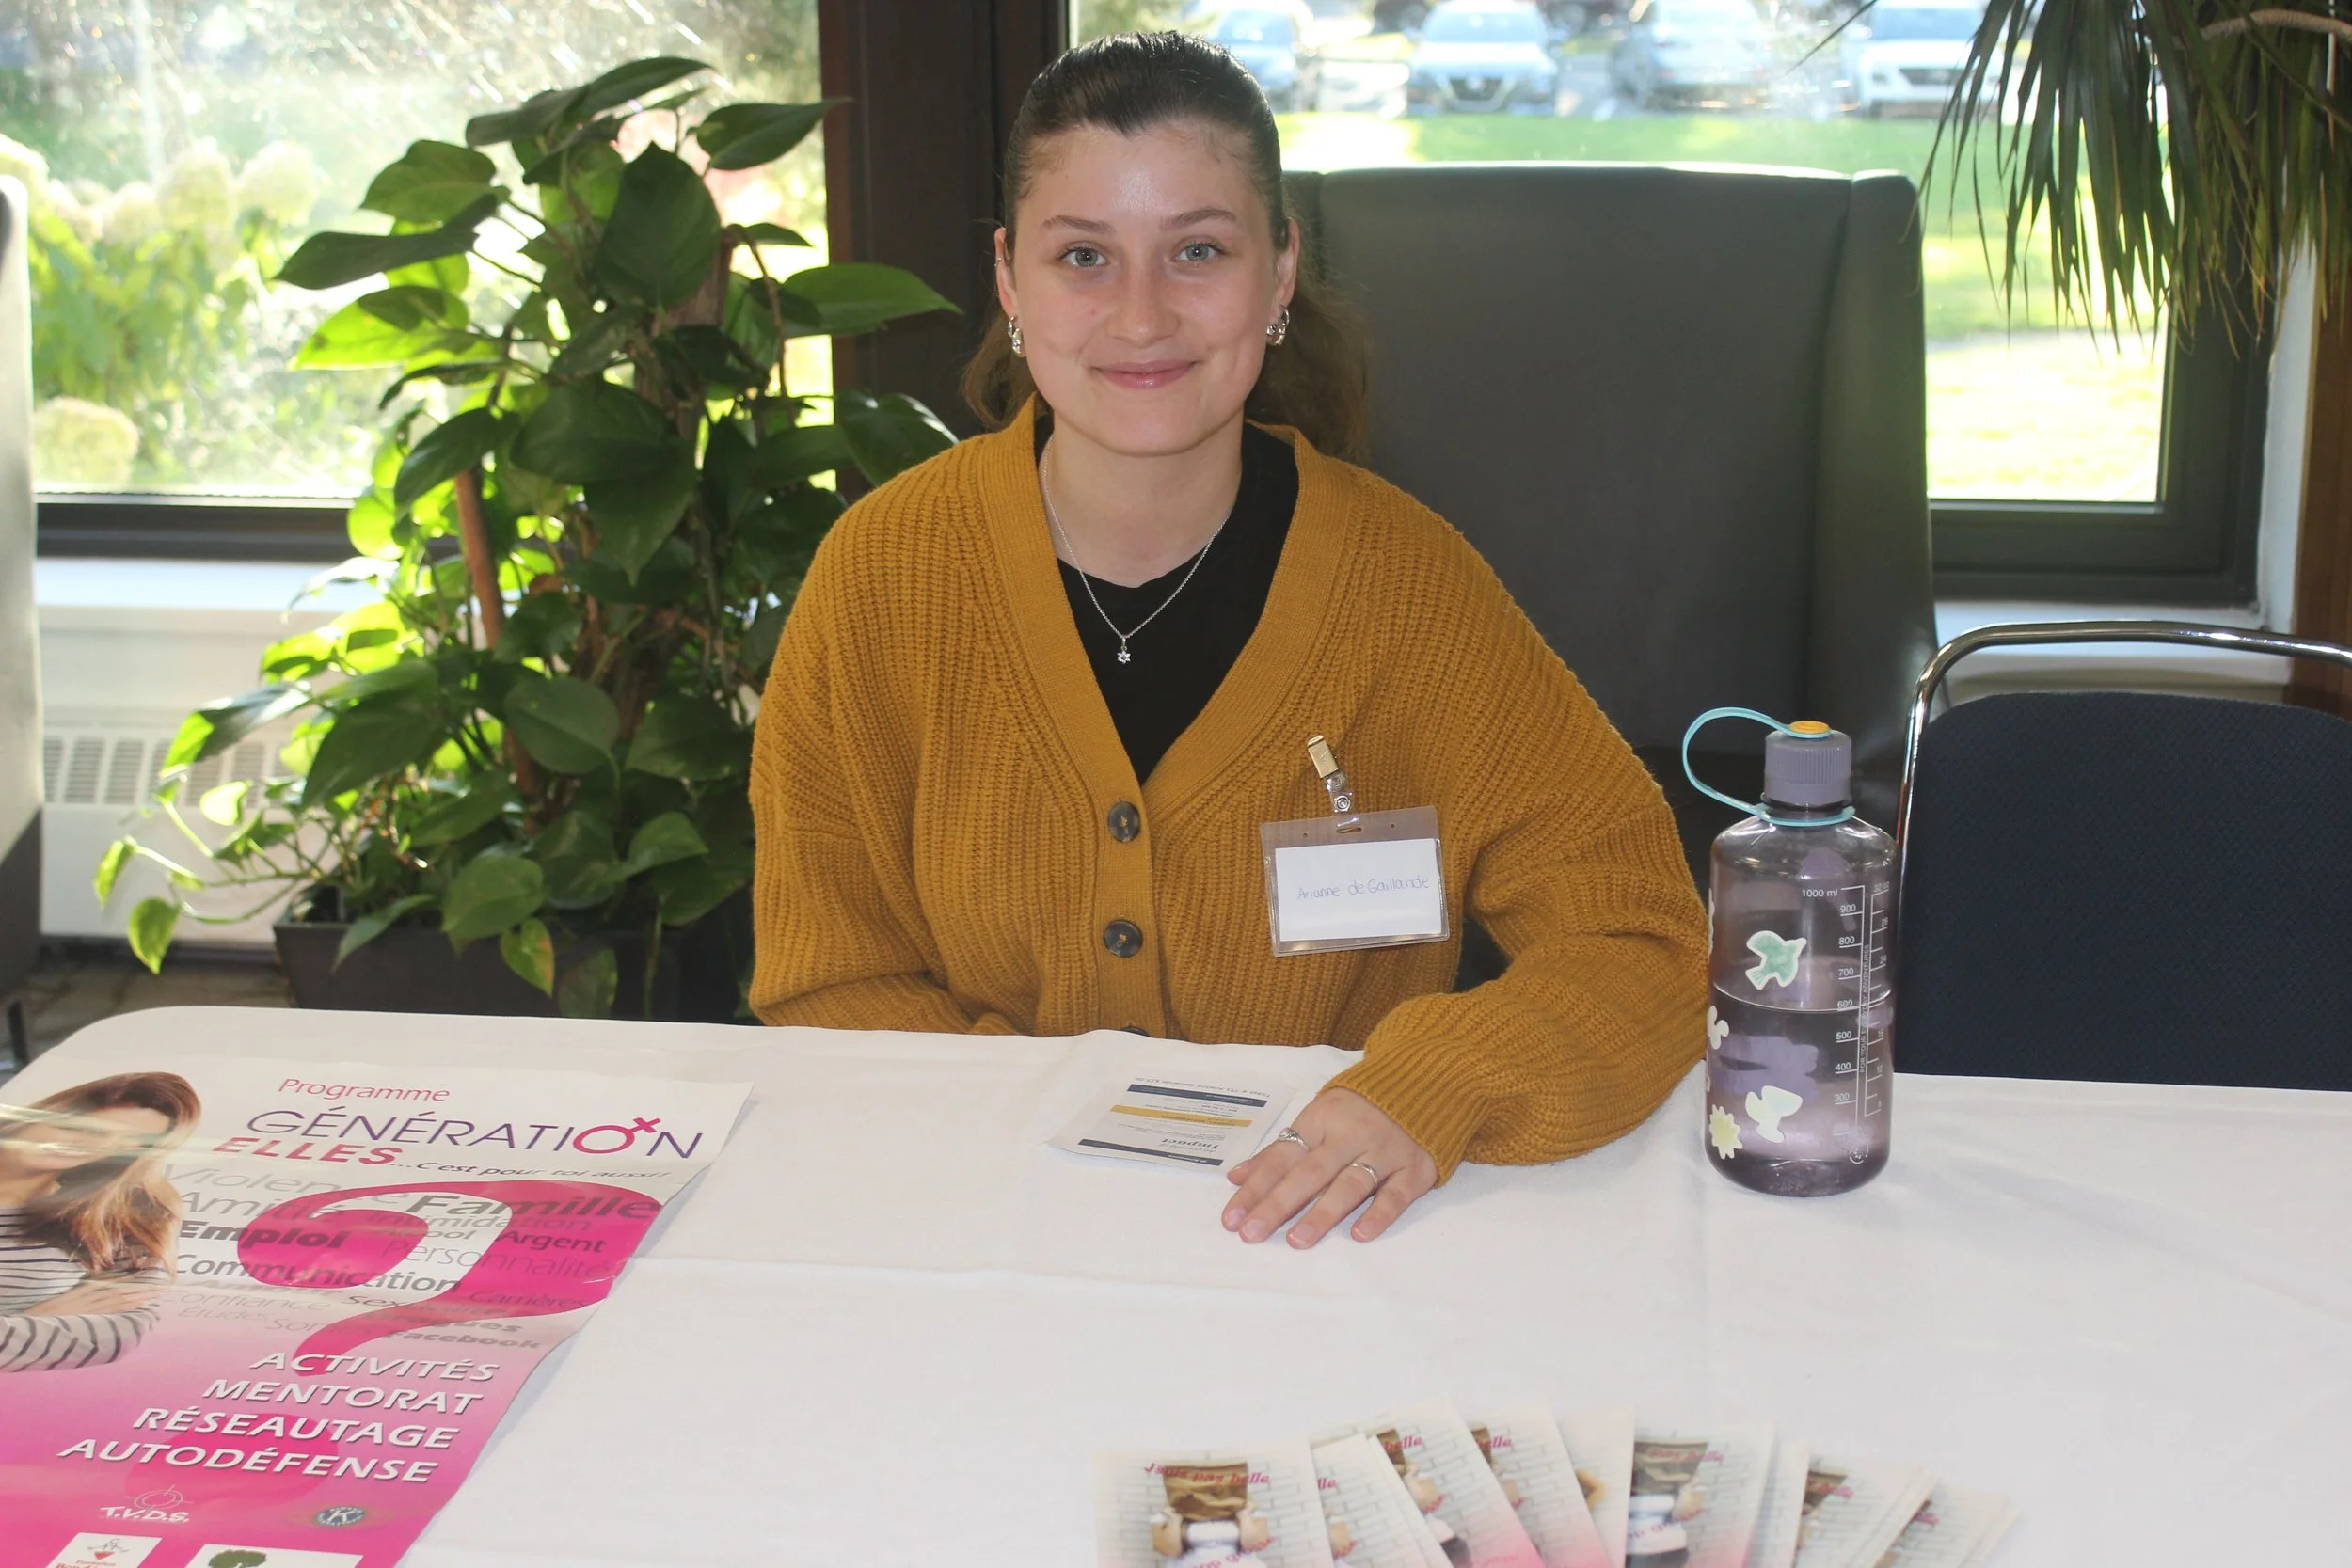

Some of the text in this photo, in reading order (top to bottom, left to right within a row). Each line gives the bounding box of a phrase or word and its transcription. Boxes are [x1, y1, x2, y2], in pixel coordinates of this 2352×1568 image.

[1348, 879, 1364, 895] de
[1802, 888, 1838, 897] 1000 ml
[1840, 904, 1856, 913] 900
[1838, 936, 1855, 945] 800
[1838, 967, 1854, 976] 700
[1837, 999, 1852, 1009] 600
[1836, 1031, 1852, 1039] 500
[1836, 1062, 1851, 1071] 400
[278, 1078, 450, 1101] Programme
[1834, 1092, 1850, 1101] 300
[247, 1106, 704, 1158] GÉNÉRATION
[212, 1137, 404, 1164] ELLES
[477, 1166, 546, 1176] pour
[164, 1164, 408, 1204] Violene
[405, 1193, 662, 1220] Famille
[179, 1219, 351, 1249] Emploi
[494, 1229, 608, 1253] Argent
[380, 1240, 610, 1278] Personnalité
[175, 1254, 462, 1293] Communication
[249, 1352, 500, 1382] ACTIVITÉS
[203, 1378, 484, 1415] MENTORAT
[133, 1405, 460, 1449] RÉSEAUTAGE
[56, 1439, 438, 1483] AUTODÉFENSE
[1318, 1477, 1337, 1490] lle
[100, 1506, 190, 1523] T.V.D.S.
